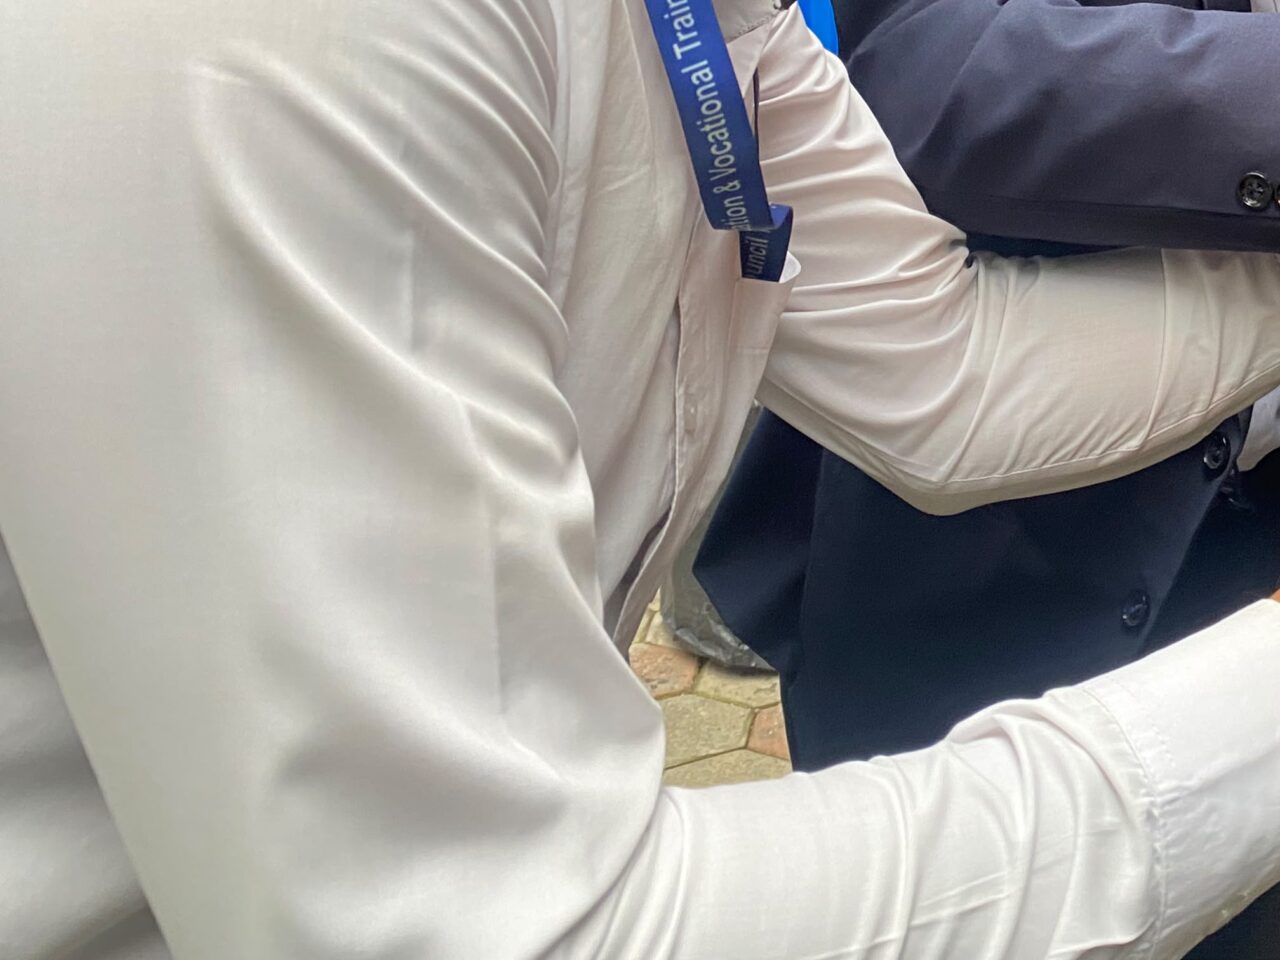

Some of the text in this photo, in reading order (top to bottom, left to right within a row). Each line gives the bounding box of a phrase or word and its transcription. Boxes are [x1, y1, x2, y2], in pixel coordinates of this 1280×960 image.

[681, 60, 737, 181] Vocational
[713, 179, 741, 194] &
[744, 234, 769, 276] uncil
